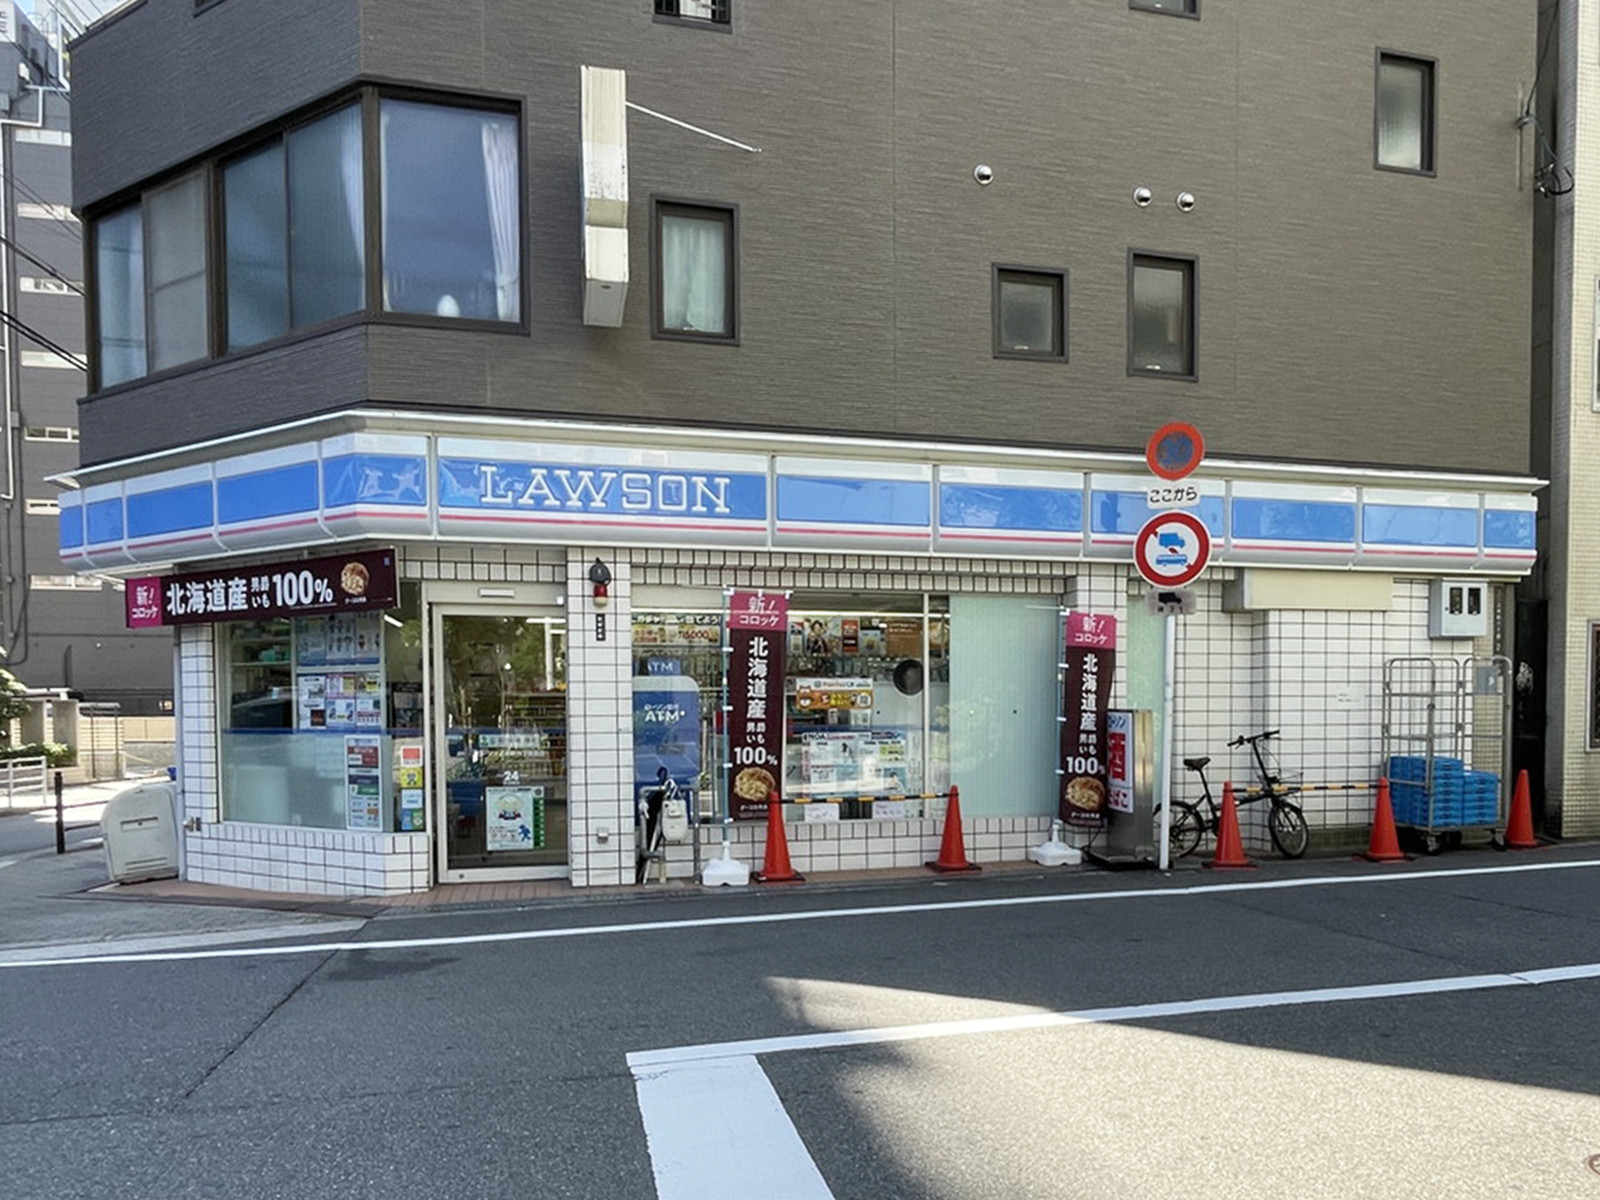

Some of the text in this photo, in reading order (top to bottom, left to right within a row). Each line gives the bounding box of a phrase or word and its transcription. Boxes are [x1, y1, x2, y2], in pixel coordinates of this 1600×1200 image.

[480, 466, 731, 513] LAWSON
[1149, 486, 1197, 503] ここから
[273, 570, 333, 607] 100%
[166, 577, 248, 616] 北海道産
[251, 593, 270, 608] いも
[132, 606, 158, 619] コロッケ
[739, 614, 779, 627] コロッケ
[1075, 633, 1107, 645] コロッケ
[747, 637, 768, 719] 北海道産
[1080, 653, 1098, 731] 北海道産
[644, 710, 679, 723] ATM
[746, 733, 766, 744] いも
[734, 746, 778, 766] 100%
[1079, 745, 1097, 756] いも
[503, 771, 520, 781] 24
